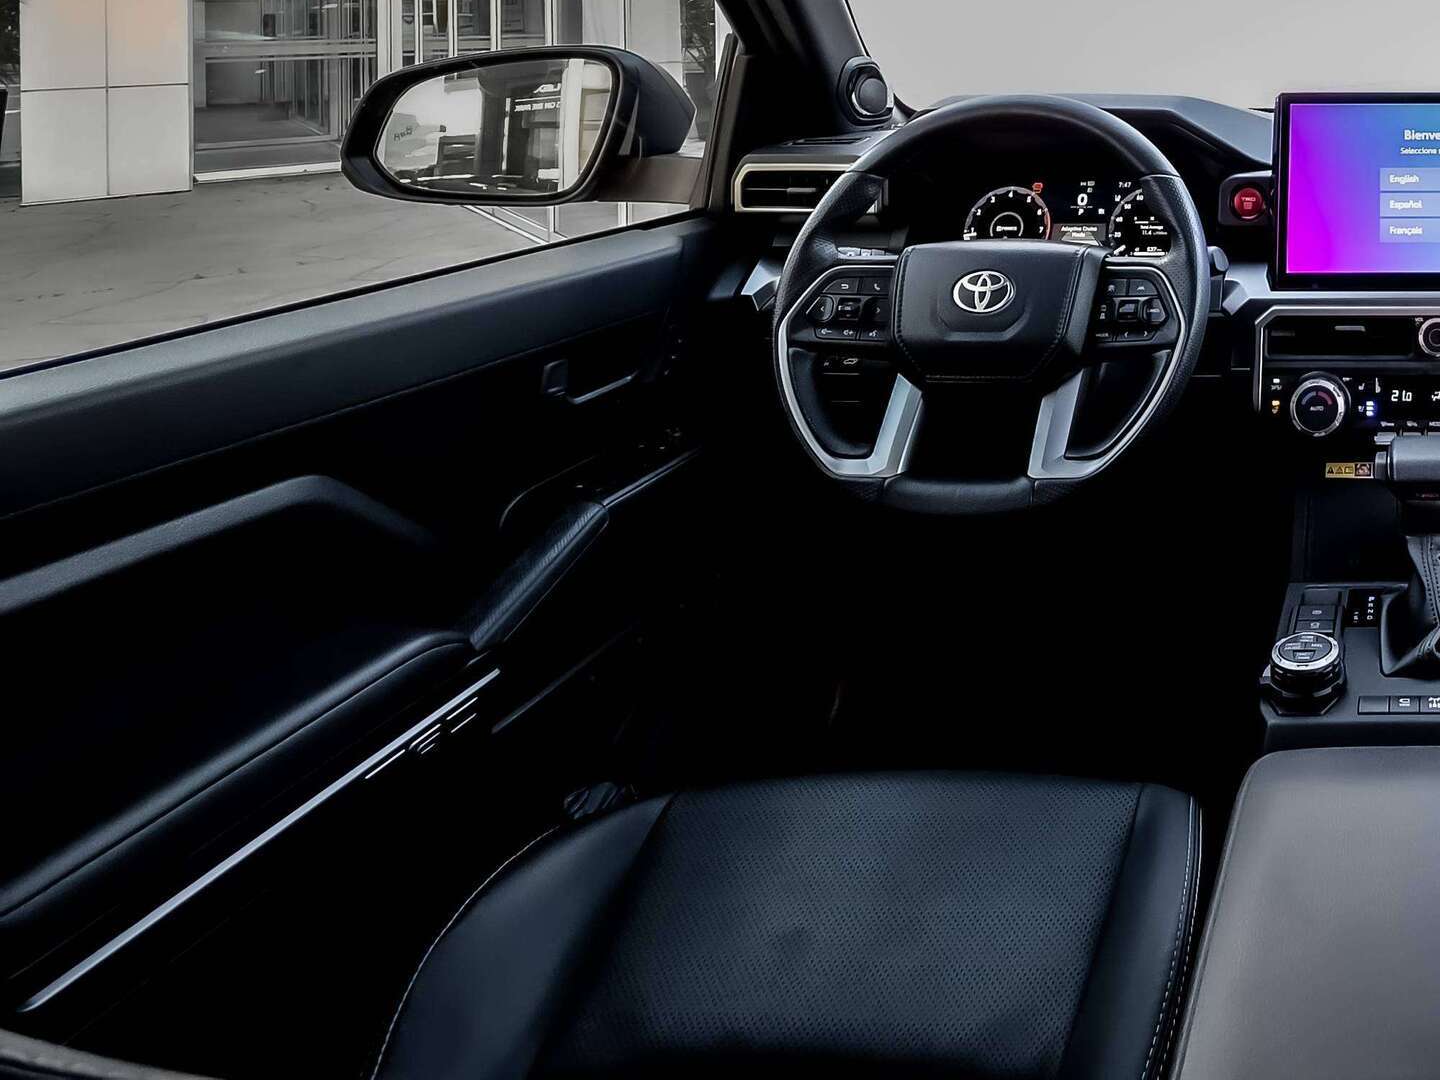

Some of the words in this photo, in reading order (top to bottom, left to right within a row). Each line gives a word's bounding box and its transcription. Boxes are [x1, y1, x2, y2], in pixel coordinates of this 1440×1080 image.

[1389, 174, 1419, 184] English
[1077, 193, 1088, 206] 0
[1389, 199, 1422, 210] Español
[1389, 225, 1422, 235] Français
